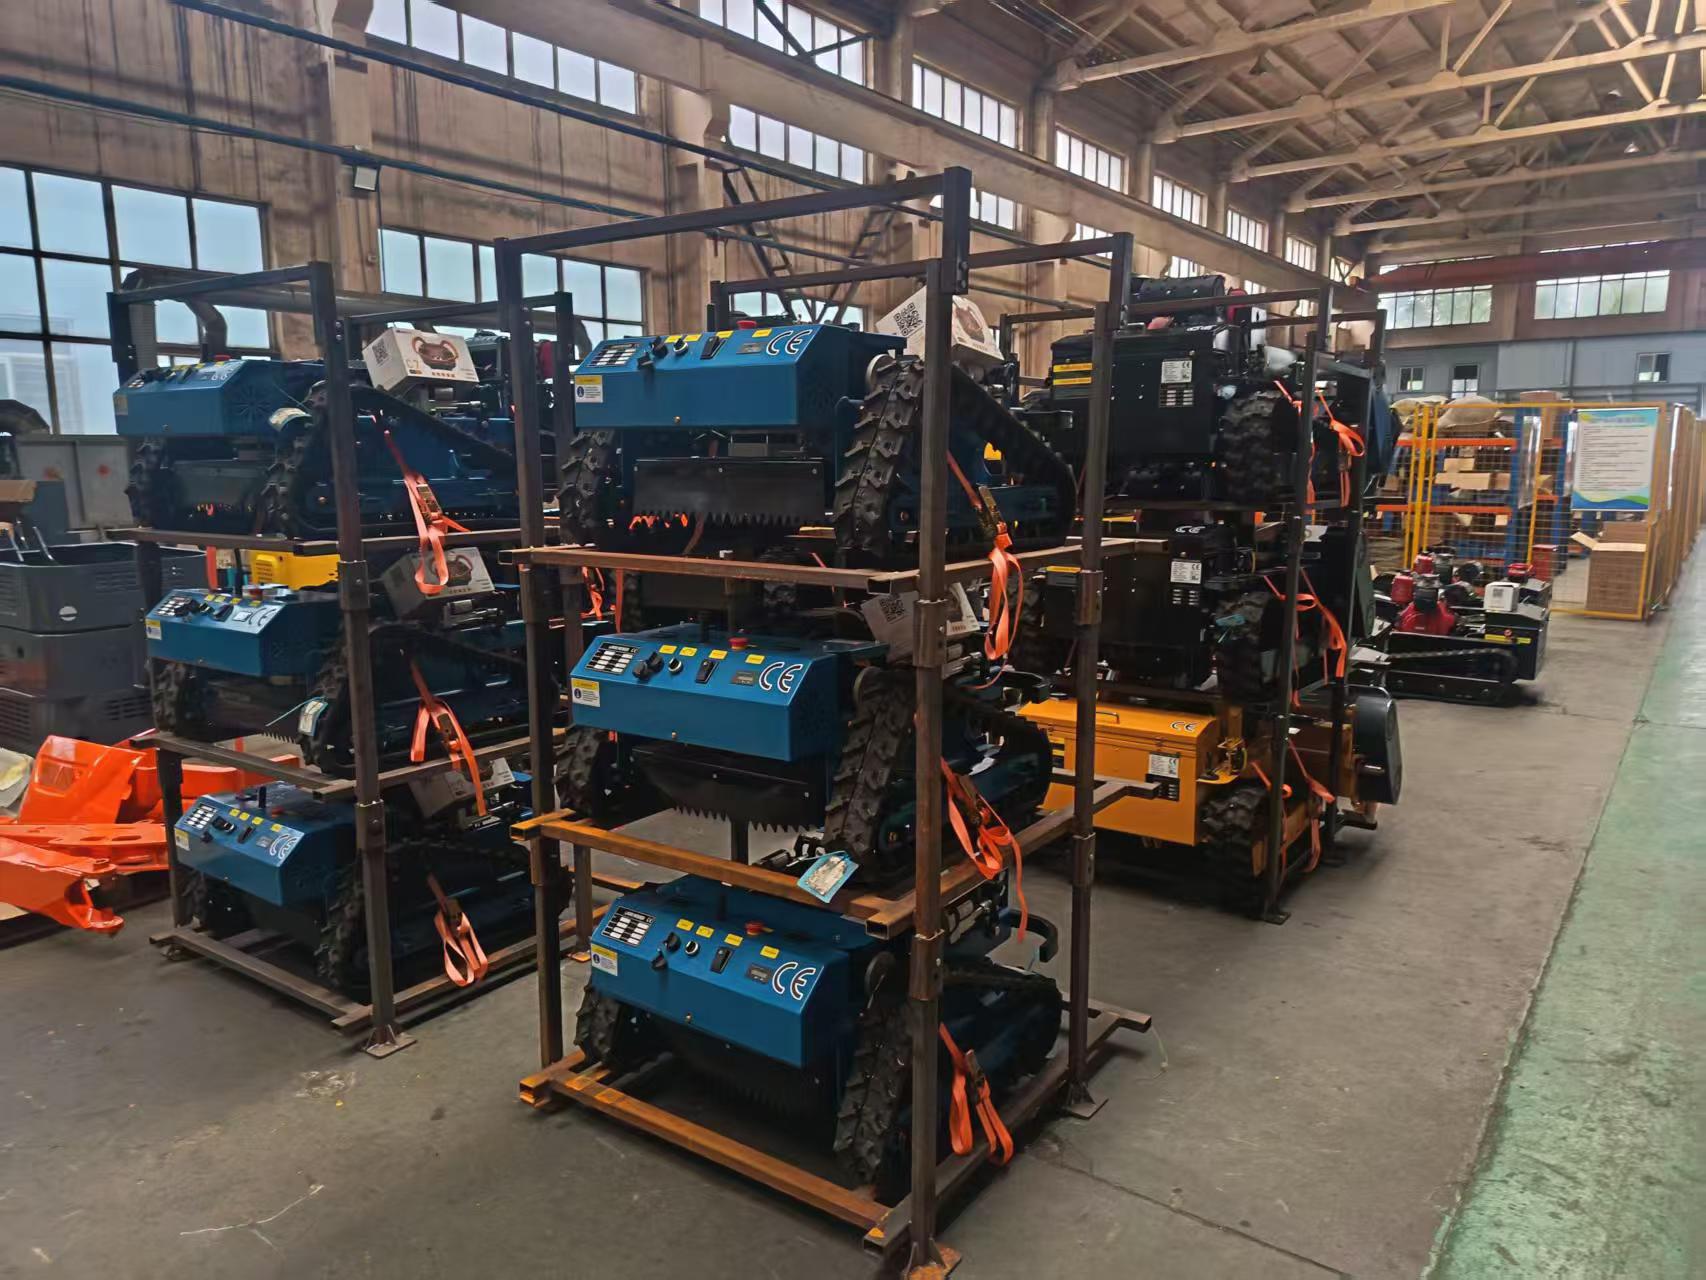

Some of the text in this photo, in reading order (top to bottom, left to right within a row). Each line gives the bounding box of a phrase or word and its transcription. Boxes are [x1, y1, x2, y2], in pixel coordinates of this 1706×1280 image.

[766, 329, 813, 356] CE
[759, 661, 803, 693] CE
[1170, 720, 1198, 733] CE
[269, 833, 299, 860] CE
[772, 961, 817, 1001] CE
